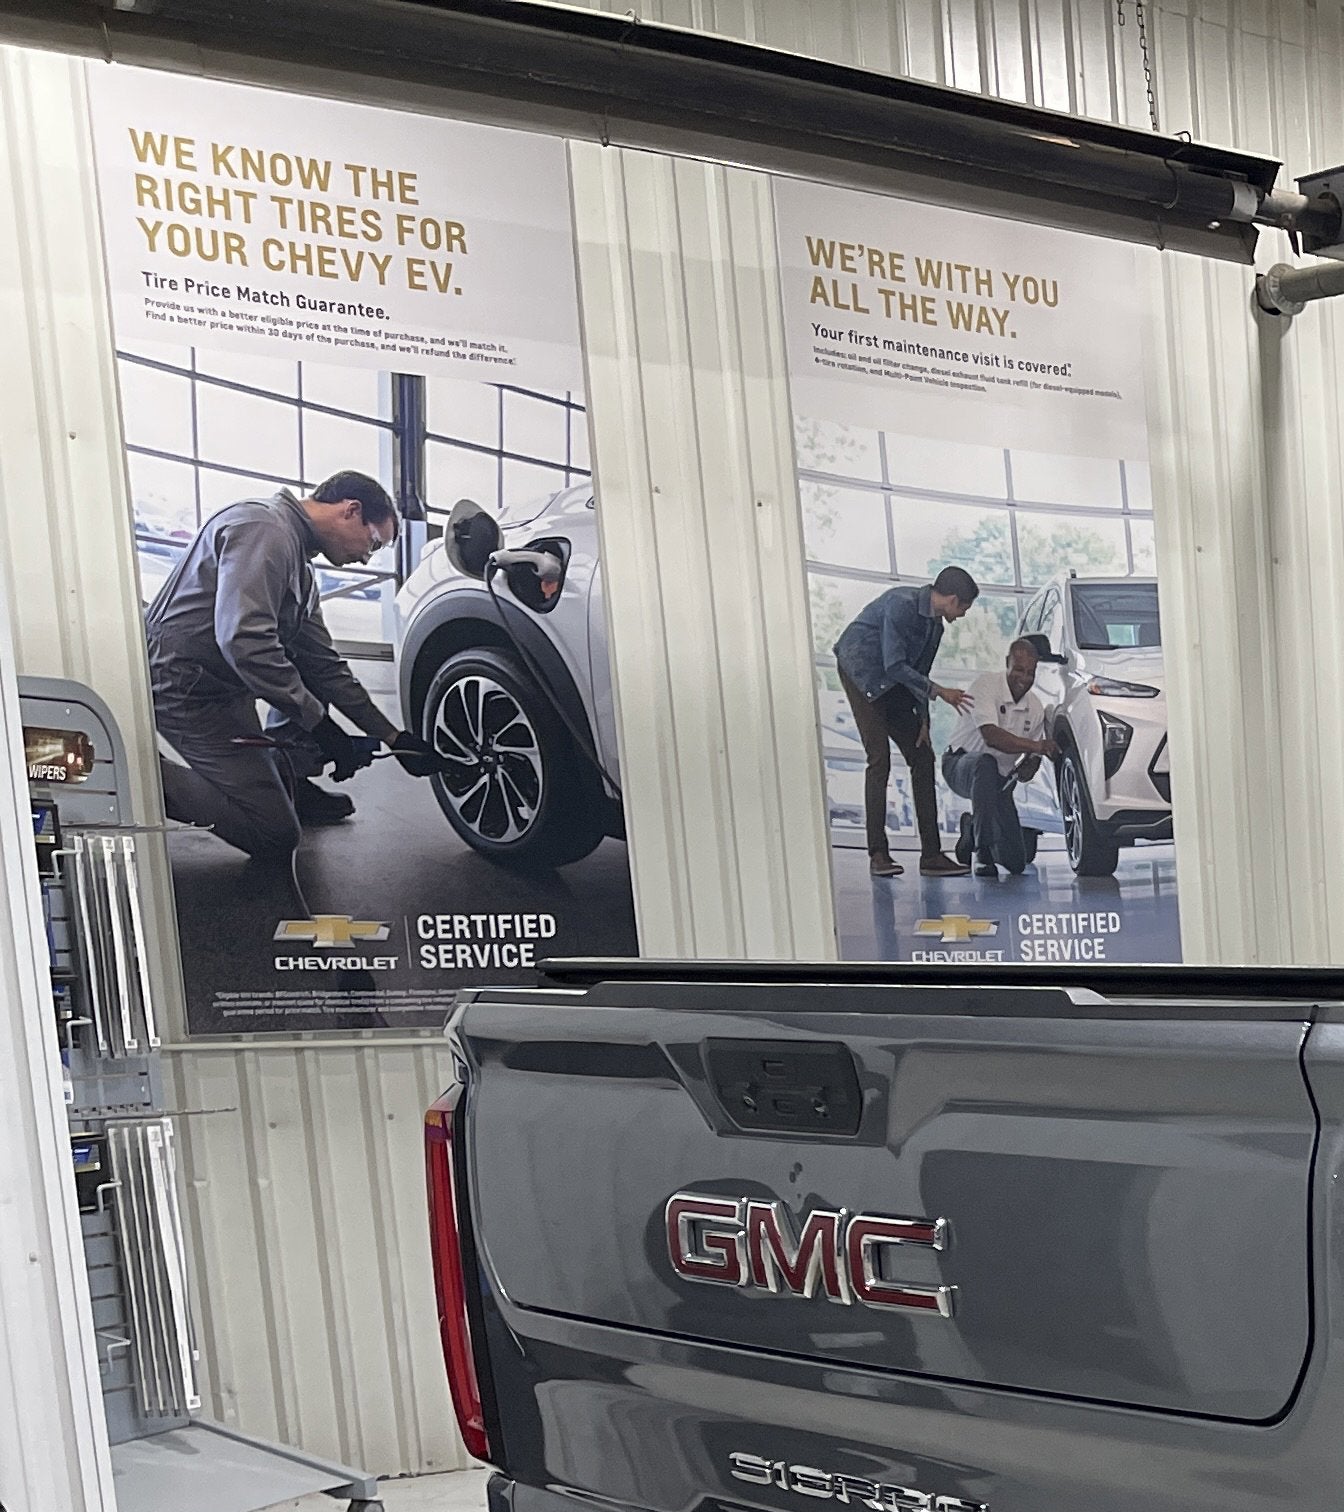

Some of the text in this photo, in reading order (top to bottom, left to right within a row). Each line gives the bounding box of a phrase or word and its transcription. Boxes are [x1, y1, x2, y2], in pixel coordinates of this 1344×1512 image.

[128, 128, 419, 206] WE KNOW THE
[135, 173, 468, 254] RIGHT TIRES FOR
[136, 217, 463, 295] YOUR CHEVY EV.
[805, 236, 1058, 308] WE'RE WITH YOU
[141, 271, 391, 320] Tire Price Match Guarantee.
[810, 276, 1017, 338] ALL THE WAY.
[145, 298, 181, 310] Provide
[184, 303, 195, 312] us
[197, 306, 218, 317] with
[229, 311, 258, 322] better
[261, 315, 293, 327] eligible
[296, 321, 319, 331] price
[322, 324, 331, 332] at
[333, 325, 348, 333] the
[350, 326, 371, 336] time
[373, 329, 382, 338] of
[384, 332, 427, 345] purchase,
[430, 337, 446, 346] and
[448, 339, 468, 348] we'll
[470, 341, 497, 352] match
[146, 311, 166, 321] Find
[178, 316, 207, 327] better
[210, 321, 234, 331] price
[236, 324, 265, 335] within
[268, 328, 280, 337] 30
[282, 330, 304, 341] days
[305, 333, 315, 342] of
[317, 334, 332, 344] the
[381, 343, 397, 352] and
[399, 345, 419, 354] we'll
[421, 347, 450, 358] refund
[452, 350, 467, 360] the
[811, 322, 844, 342] Your
[848, 329, 879, 349] first
[882, 337, 969, 363] maintenance
[972, 350, 1000, 368] visit
[1003, 355, 1015, 370] is
[28, 764, 67, 781] WIPERS
[417, 914, 557, 939] CERTIFIED
[1018, 912, 1121, 935] CERTIFIED
[274, 956, 399, 971] CHEVROLET
[419, 943, 536, 969] SERVICE
[912, 950, 1004, 963] CHEVROLET
[1020, 938, 1106, 961] SERVICE
[665, 1190, 957, 1318] GMC
